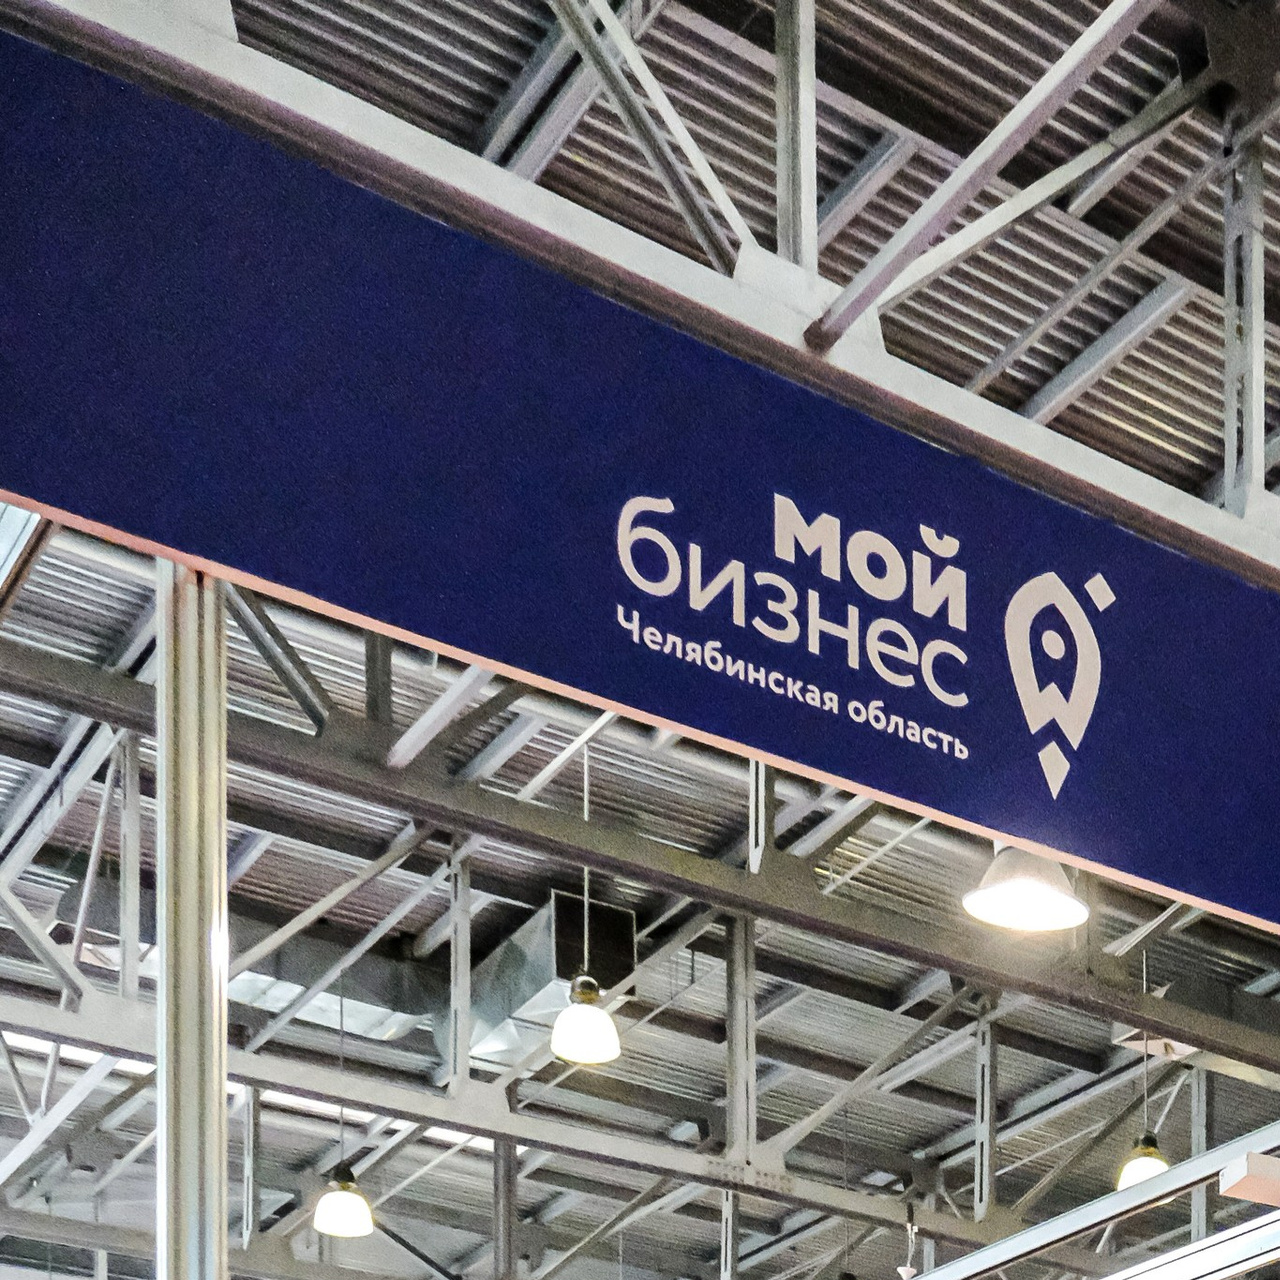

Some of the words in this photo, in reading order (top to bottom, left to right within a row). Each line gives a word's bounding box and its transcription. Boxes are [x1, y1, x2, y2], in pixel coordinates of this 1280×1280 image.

[616, 604, 839, 714] Челябинская
[848, 699, 969, 760] область
[617, 496, 969, 707] бизнес
